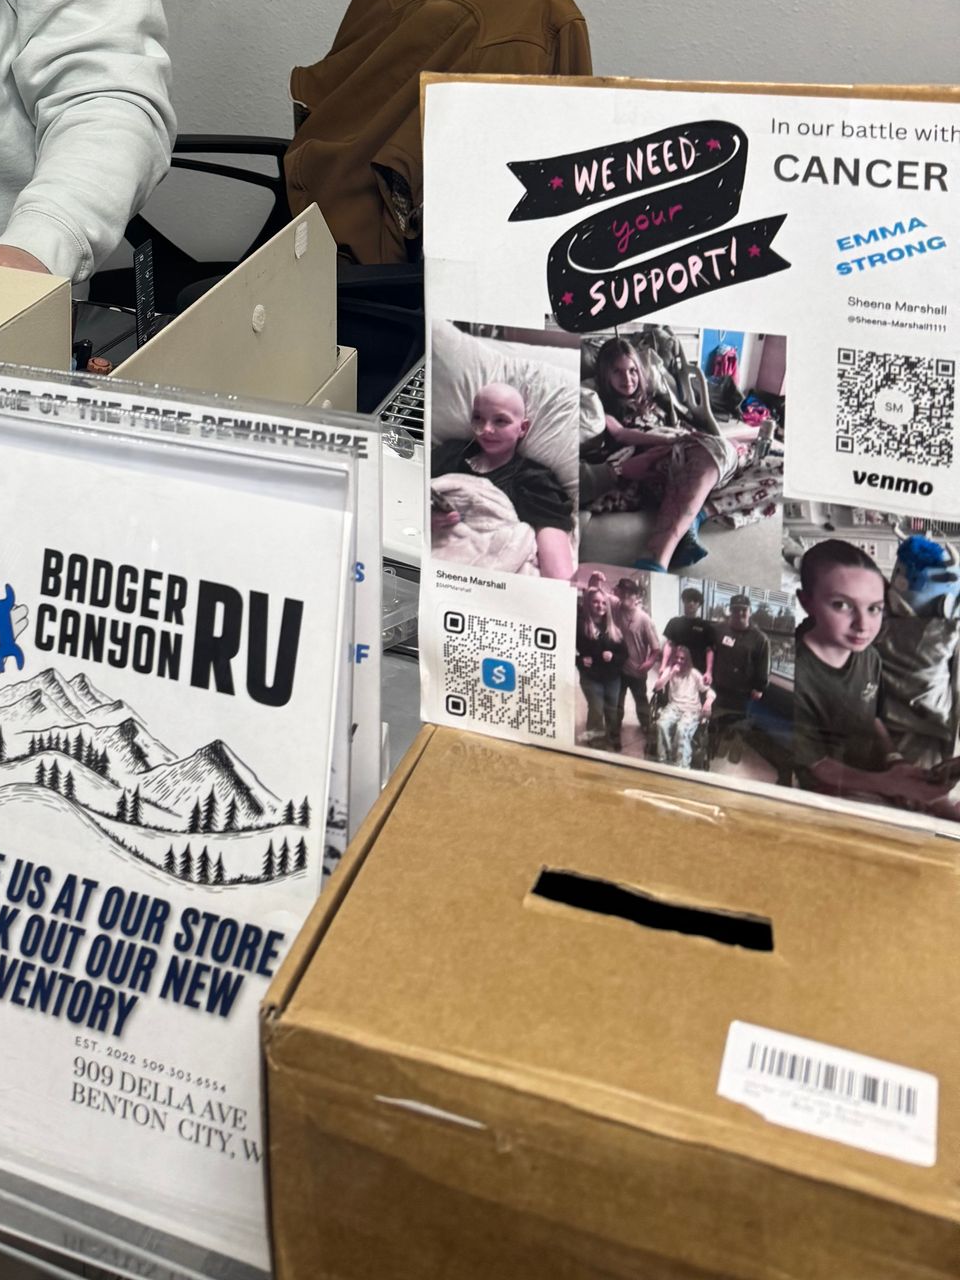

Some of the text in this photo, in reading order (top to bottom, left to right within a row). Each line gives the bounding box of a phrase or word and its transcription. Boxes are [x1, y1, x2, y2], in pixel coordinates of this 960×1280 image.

[771, 117, 960, 143] In our battle with
[573, 136, 696, 196] WE NEED
[774, 154, 948, 192] CANCER
[612, 203, 684, 254] your
[836, 217, 927, 252] EMMA
[588, 236, 738, 317] SUPPORT!
[835, 233, 948, 276] STRONG
[848, 296, 947, 315] Sheena Marshall
[41, 393, 68, 416] OF
[77, 397, 122, 424] THE
[131, 404, 192, 436] FREE
[885, 401, 903, 414] SM
[853, 470, 934, 498] venmo
[40, 547, 188, 626] BADGER
[436, 570, 506, 590] Sheena Marshall
[35, 603, 183, 681] CANYON
[6, 858, 53, 911] US
[51, 872, 99, 923] AT
[97, 885, 172, 945] OUR
[173, 907, 286, 977] STORE
[18, 914, 87, 970] OUT
[85, 933, 158, 994] OUR
[159, 955, 246, 1018] NEW
[75, 1035, 227, 1094] EST. 2022 509.303.6554
[73, 1055, 248, 1132] 909 DELLA AVE
[70, 1082, 264, 1164] BENTON CITY, W
